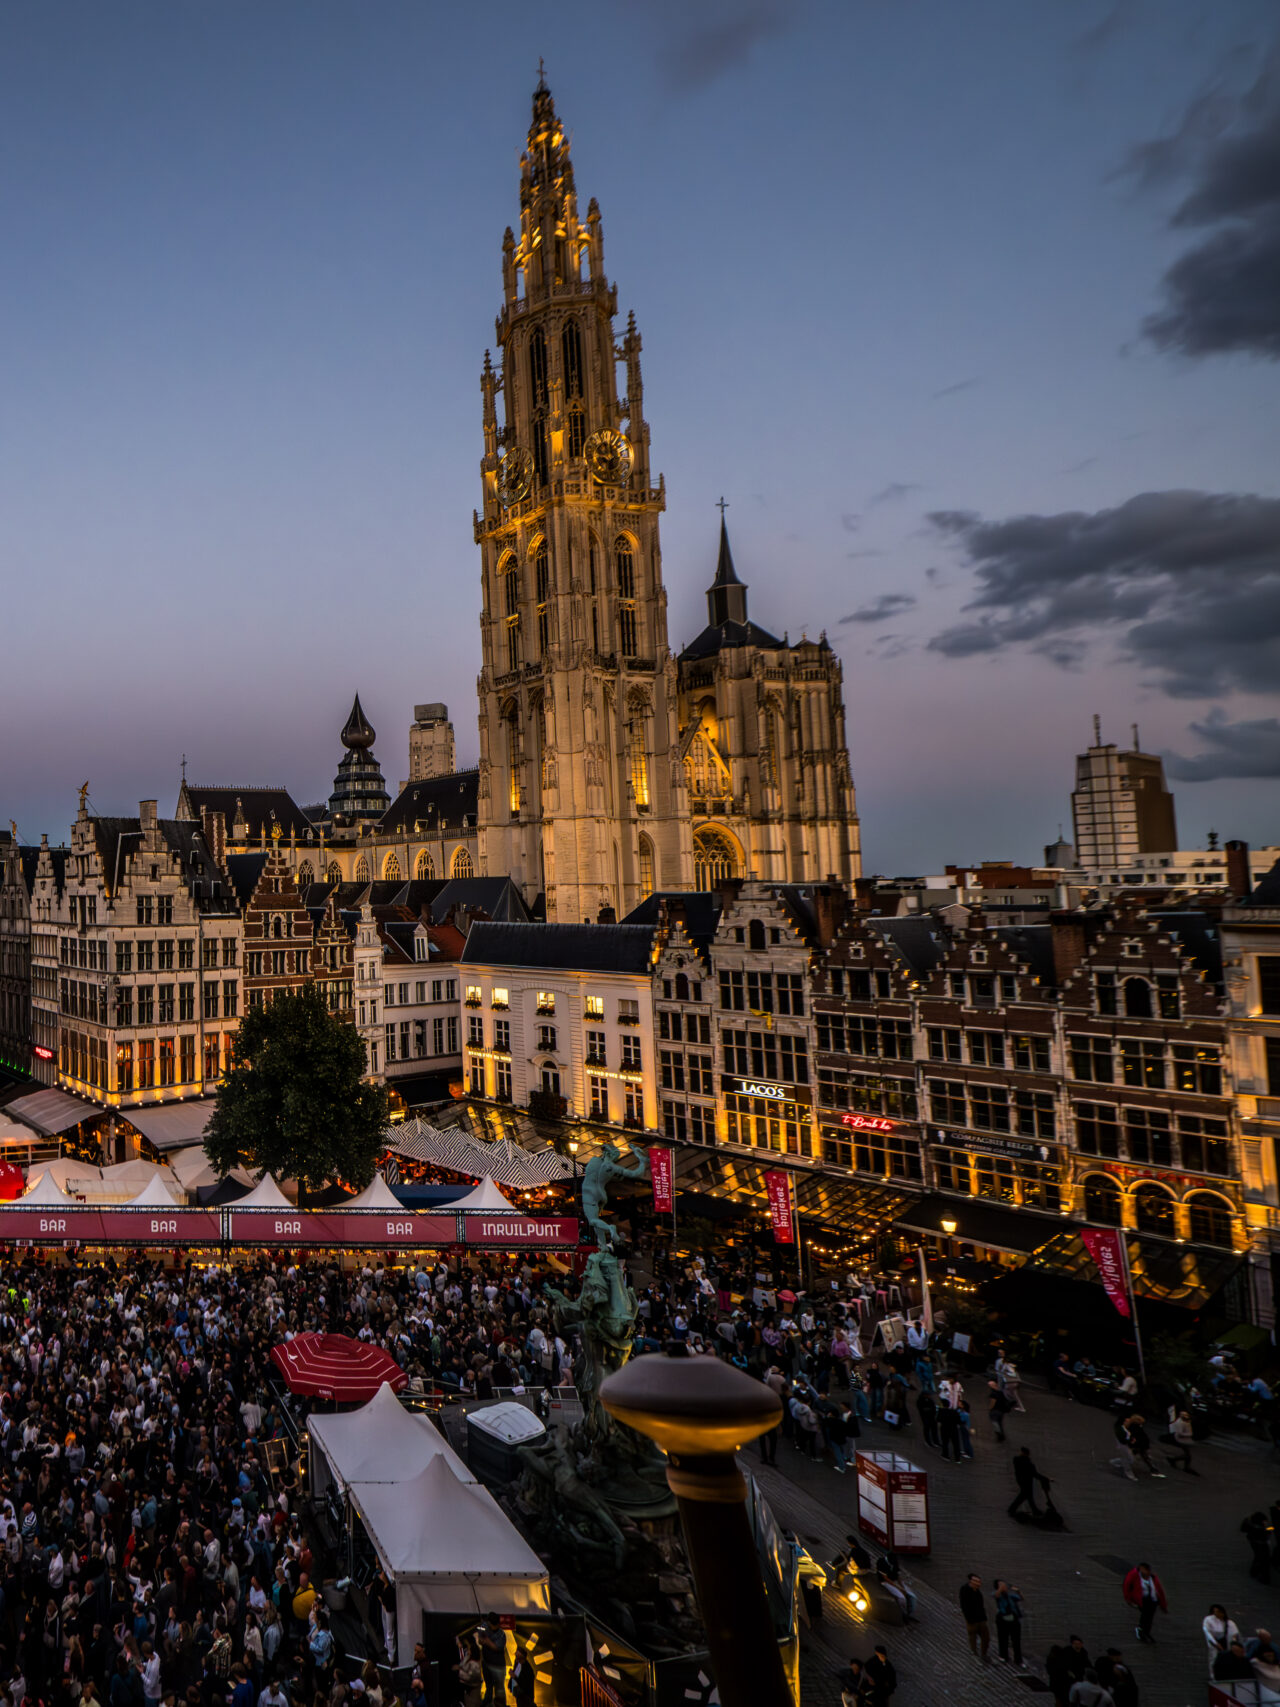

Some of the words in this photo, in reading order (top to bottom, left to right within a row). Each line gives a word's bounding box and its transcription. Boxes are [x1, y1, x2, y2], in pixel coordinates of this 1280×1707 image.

[741, 1082, 785, 1098] LACO'S
[40, 1219, 66, 1232] BAR
[151, 1220, 177, 1233] BAR
[275, 1221, 301, 1234] BAR
[386, 1222, 413, 1235] BAR
[482, 1223, 562, 1236] INRUILPUNT
